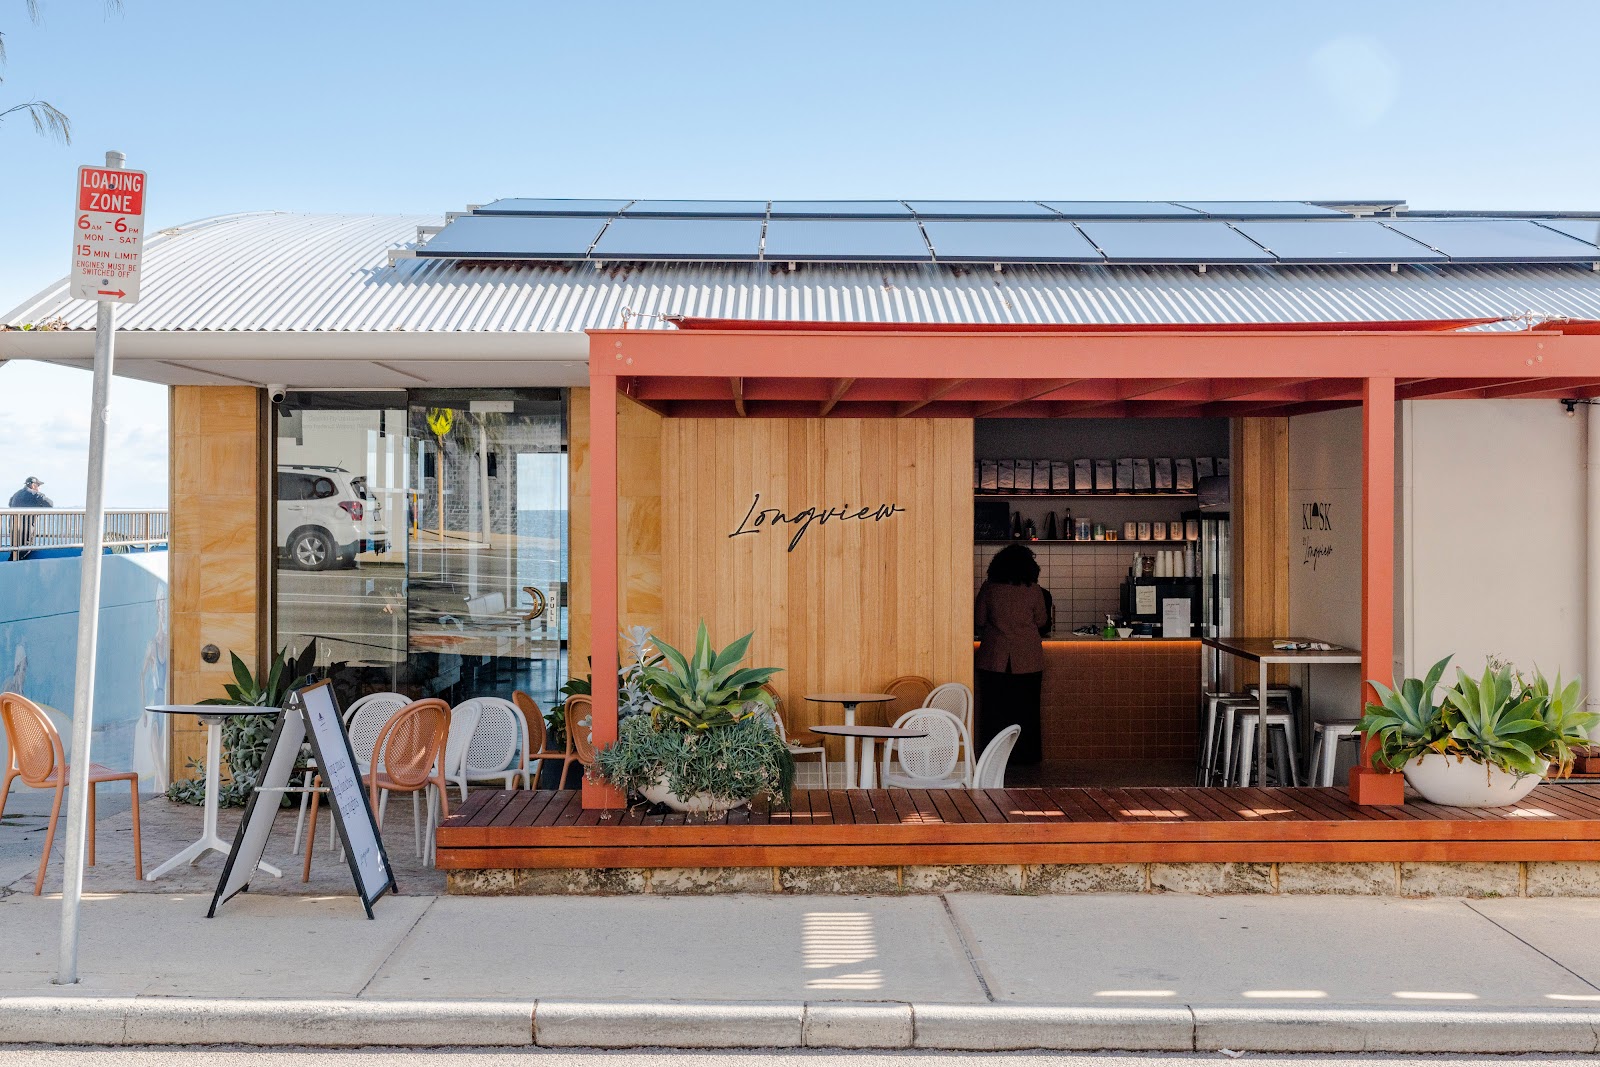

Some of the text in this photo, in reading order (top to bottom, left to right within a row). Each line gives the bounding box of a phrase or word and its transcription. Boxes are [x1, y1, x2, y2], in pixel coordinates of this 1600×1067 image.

[83, 171, 141, 192] LOADING
[90, 192, 132, 212] ZONE
[84, 233, 104, 241] MON
[77, 244, 138, 260] 15 MIN LIMIT
[76, 260, 137, 272] ENGINES MUST BE
[82, 268, 115, 277] SWITCHED
[728, 493, 906, 552] Longview
